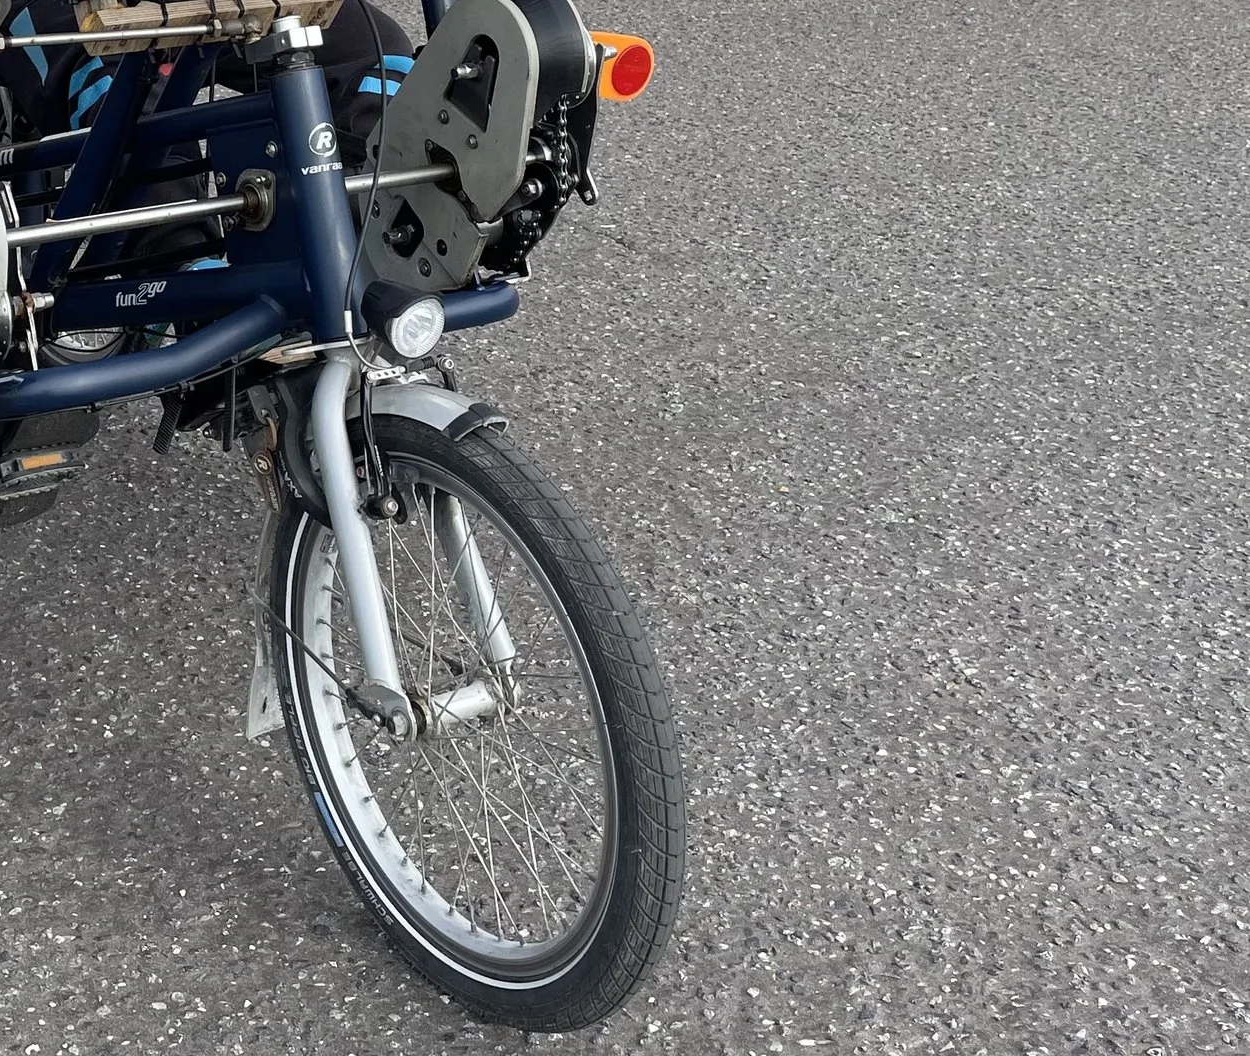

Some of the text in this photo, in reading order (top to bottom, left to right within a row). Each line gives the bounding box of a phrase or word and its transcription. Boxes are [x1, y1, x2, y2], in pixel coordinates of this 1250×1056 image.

[301, 161, 343, 176] vanraa
[115, 280, 168, 307] fun2go
[341, 850, 395, 927] SCHWALBE
